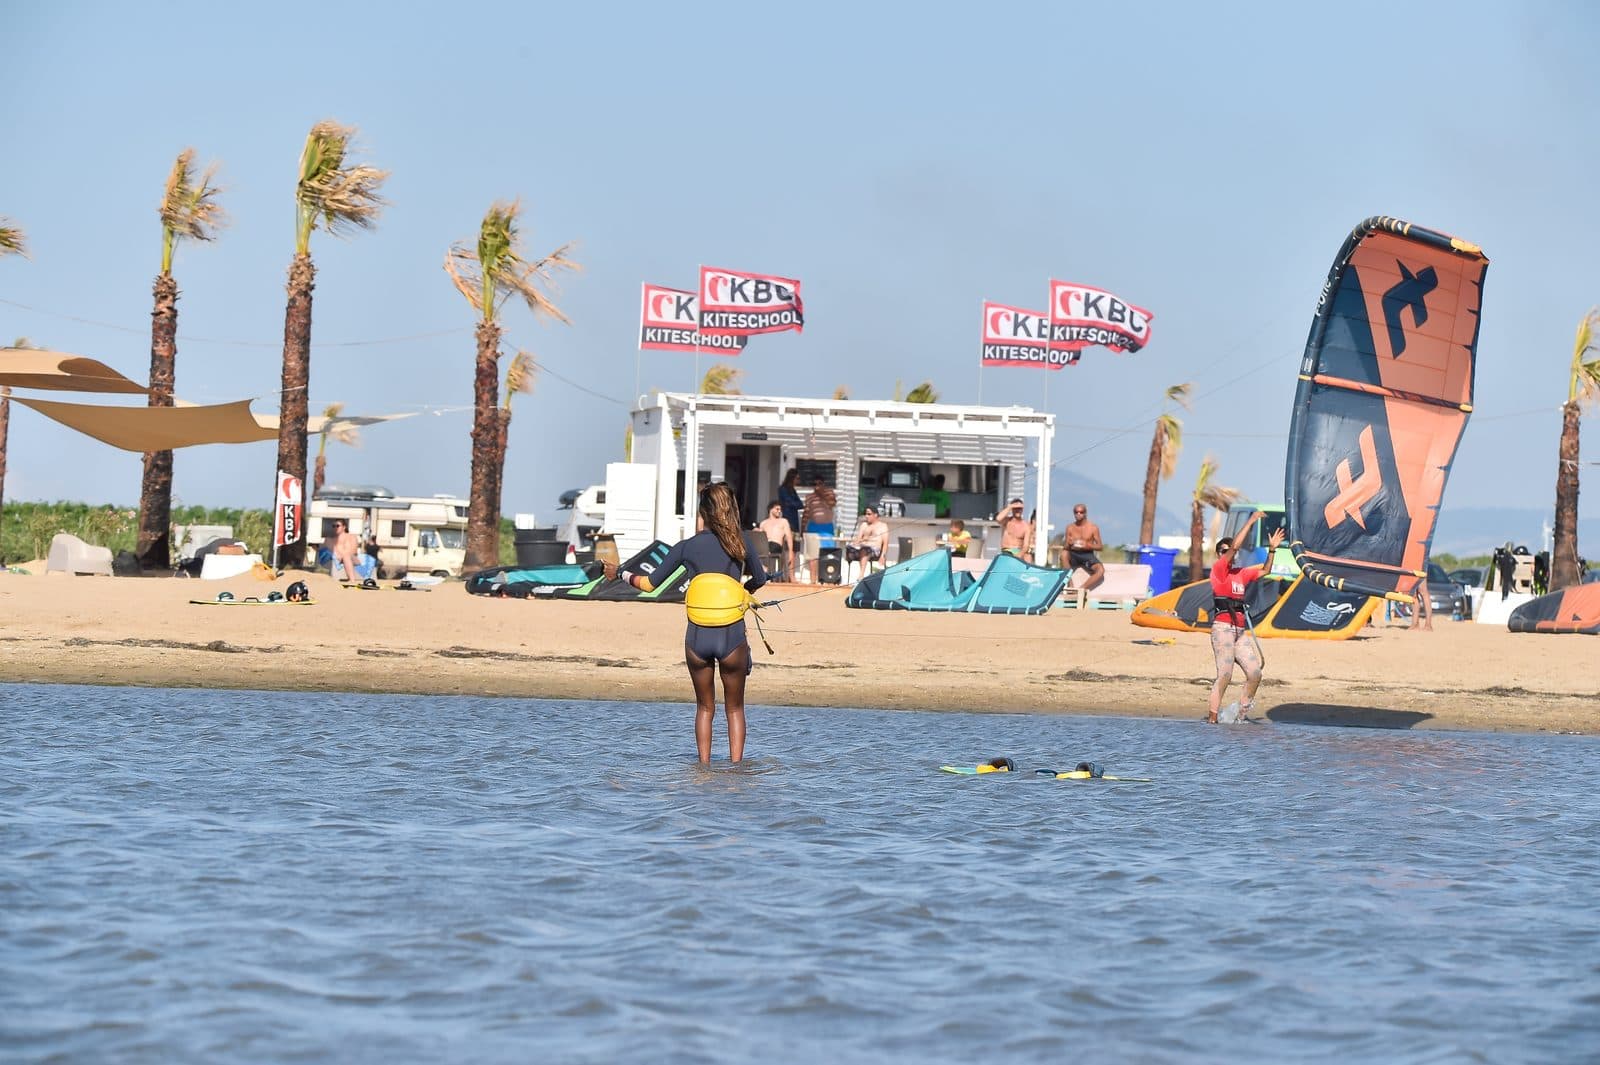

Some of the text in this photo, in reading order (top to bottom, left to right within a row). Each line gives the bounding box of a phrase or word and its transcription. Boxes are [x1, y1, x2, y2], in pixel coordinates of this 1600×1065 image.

[730, 277, 792, 303] KBC
[703, 310, 801, 328] KITESCHOOL
[645, 328, 742, 349] KITESCHOOL
[1054, 326, 1134, 348] KITESCHO
[284, 505, 294, 544] KBC
